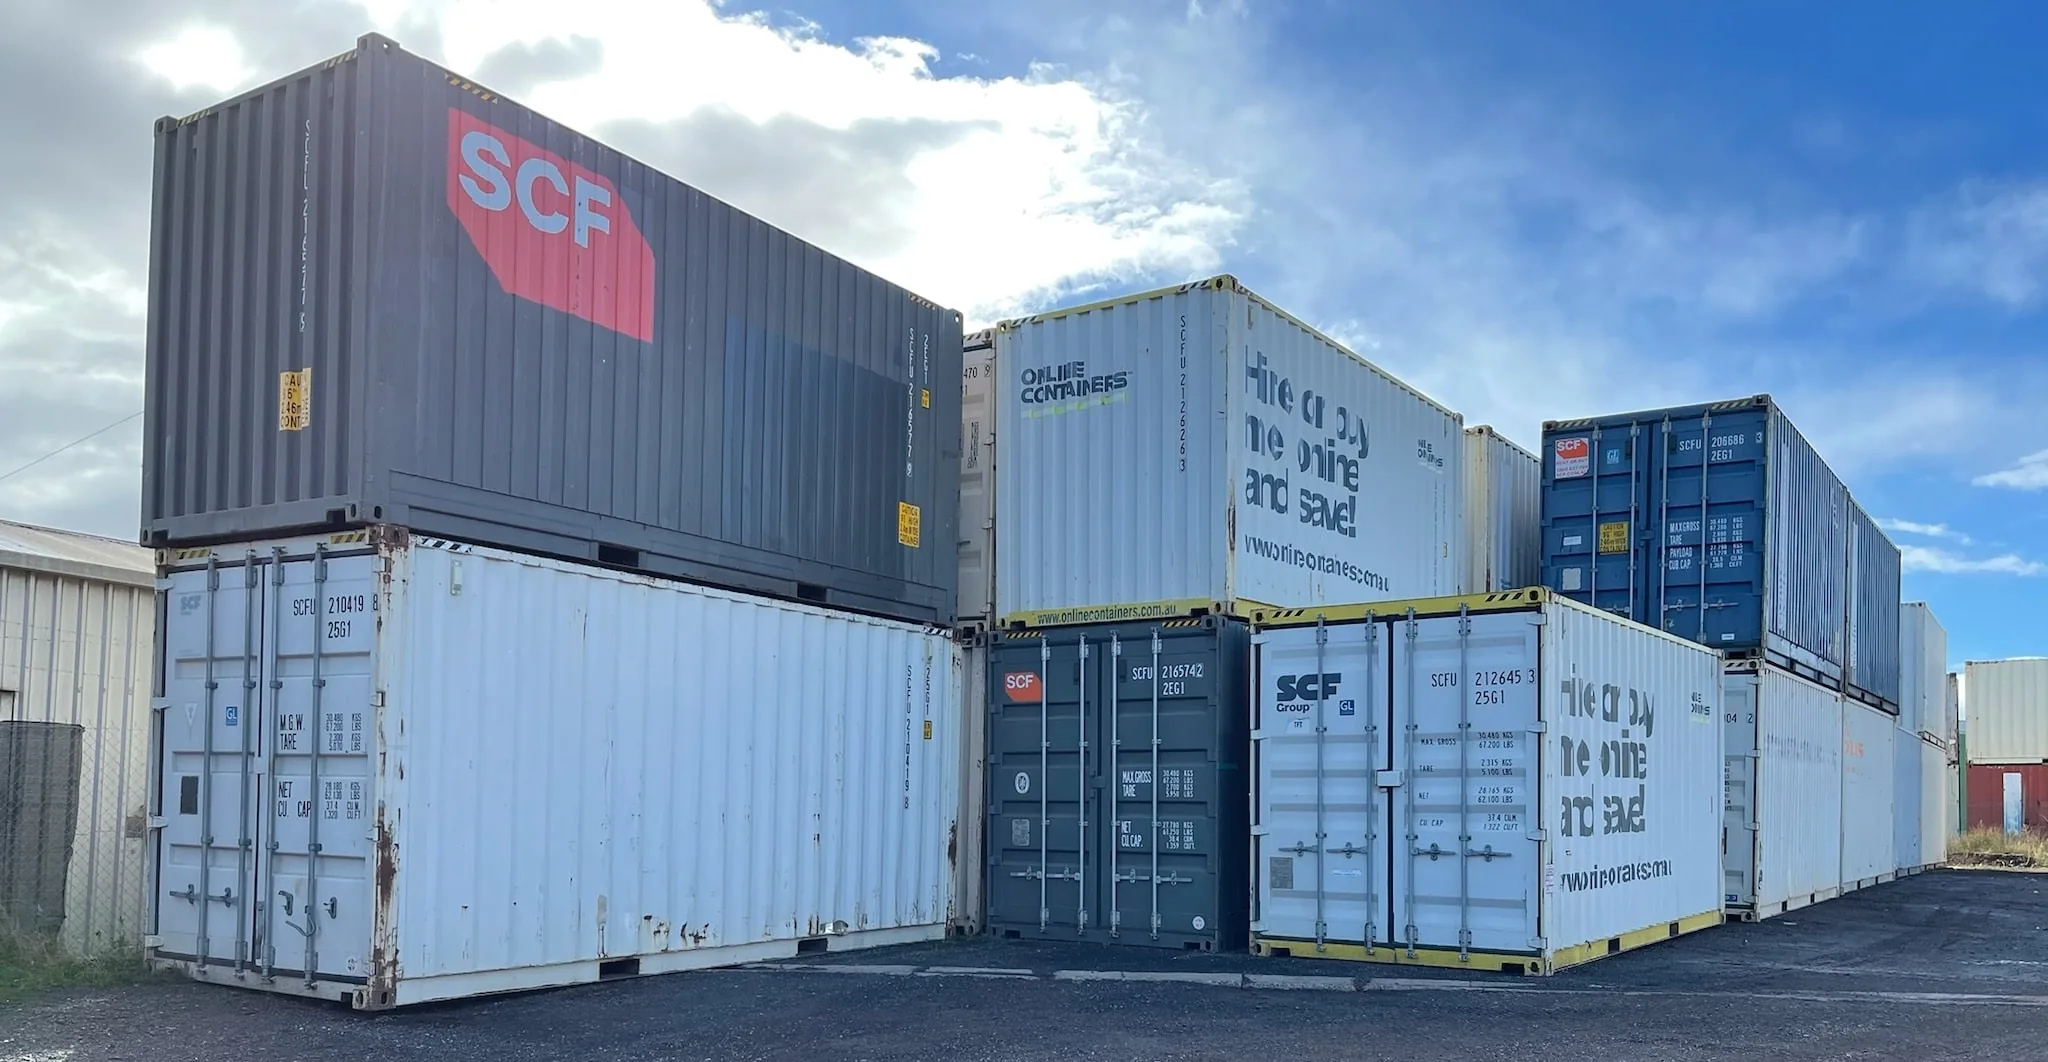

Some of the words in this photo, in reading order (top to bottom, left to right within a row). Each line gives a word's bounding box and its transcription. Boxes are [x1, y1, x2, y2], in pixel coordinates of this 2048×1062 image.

[458, 131, 611, 249] SCF
[1244, 344, 1294, 415] Hire
[1557, 440, 1581, 452] SCF
[1679, 439, 1702, 451] SCFU
[1711, 434, 1745, 448] 206686
[1756, 432, 1763, 443] 3
[1711, 449, 1732, 461] 2EG1
[1179, 459, 1185, 472] 3
[1245, 467, 1288, 514] and
[1300, 488, 1357, 538] save!
[1669, 535, 1682, 545] TARE
[1669, 547, 1693, 558] PAYLOAD
[293, 598, 316, 616] SCFU
[328, 595, 364, 614] 210419
[372, 594, 379, 611] 8
[1037, 604, 1176, 625] www.onlinecontainers.com.au
[328, 620, 351, 639] 25G1
[1132, 667, 1153, 680] SCFU
[1431, 673, 1457, 687] SCFU
[1475, 670, 1522, 686] 212645
[1528, 669, 1535, 683] 3
[1006, 675, 1033, 689] SCF
[1163, 682, 1185, 695] 2EG1
[1277, 673, 1342, 702] SCF
[1475, 690, 1505, 705] 25G1
[1276, 703, 1311, 713] Group
[1340, 701, 1354, 711] GL
[226, 707, 238, 720] GL
[280, 733, 297, 750] TARE
[1503, 731, 1514, 739] KGS
[1503, 740, 1514, 748] LBS
[1501, 759, 1513, 767] KGS
[1419, 765, 1434, 773] TARE
[1502, 768, 1513, 776] LBS
[279, 781, 293, 798] NET
[1123, 784, 1136, 797] TARE
[1502, 786, 1514, 794] KGS
[1502, 795, 1513, 803] LBS
[1121, 821, 1131, 834] NET
